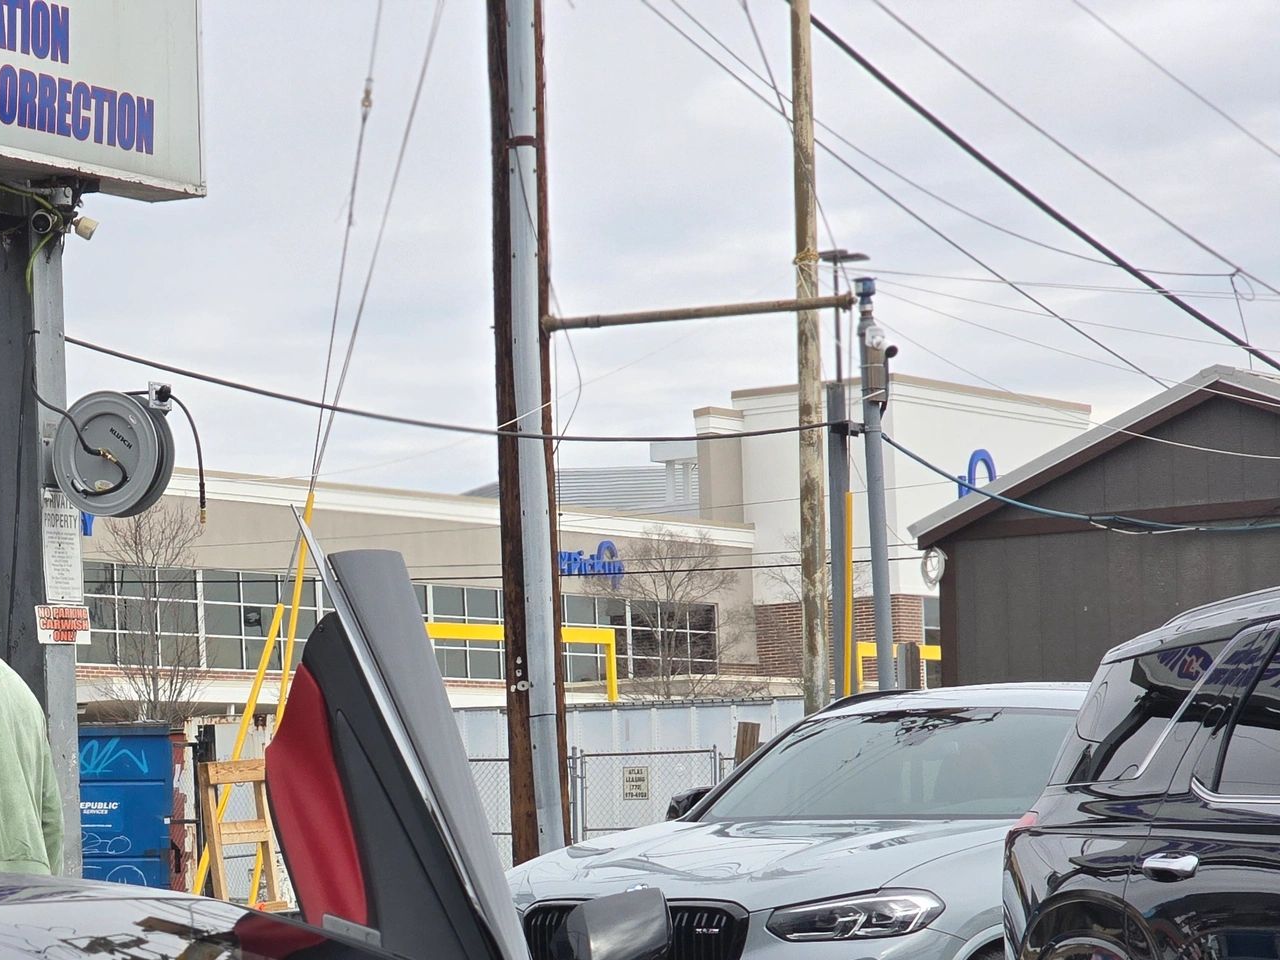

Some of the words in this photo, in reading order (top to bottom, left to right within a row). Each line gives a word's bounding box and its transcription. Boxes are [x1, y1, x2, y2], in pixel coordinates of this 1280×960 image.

[44, 513, 78, 529] PROPERTY
[38, 607, 51, 618] NO
[52, 607, 88, 619] PARKING
[39, 618, 89, 631] CARWASH
[80, 802, 119, 810] EPUBLIC
